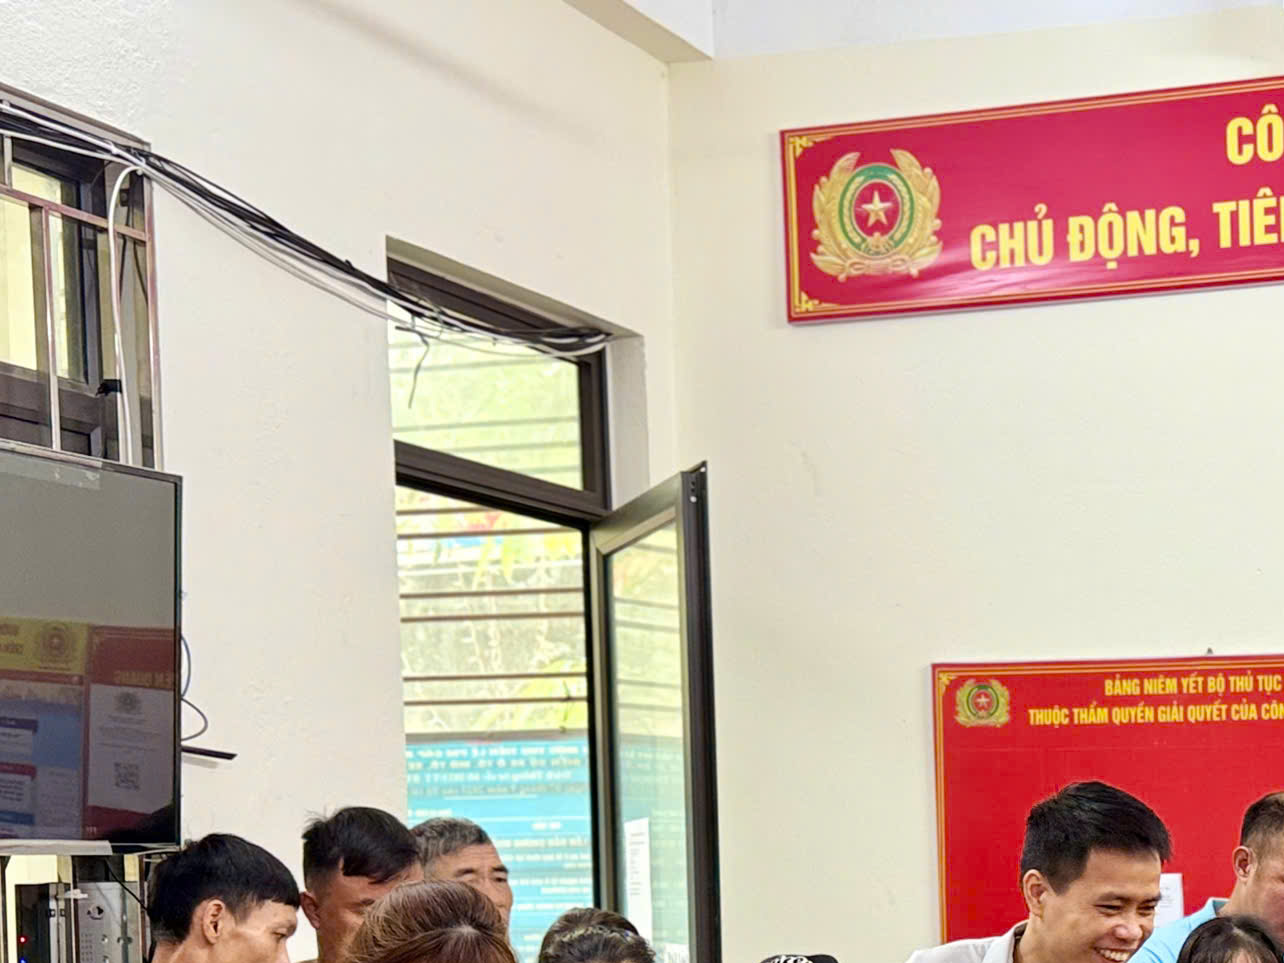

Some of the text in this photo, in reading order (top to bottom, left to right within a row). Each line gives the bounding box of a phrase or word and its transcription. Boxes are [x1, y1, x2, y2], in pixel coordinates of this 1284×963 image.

[969, 203, 1055, 271] CHỦ
[1067, 203, 1200, 272] ĐỘNG,
[1105, 675, 1140, 695] BẢNG
[1181, 674, 1204, 693] YẾT
[1208, 674, 1225, 693] BỘ
[1229, 672, 1253, 692] THỦ
[1257, 675, 1281, 694] TỤC
[1029, 706, 1069, 725] THUỘC
[1073, 705, 1108, 724] THẨM
[1112, 703, 1154, 724] QUYỀN
[1158, 701, 1184, 722] GIẢI
[1187, 701, 1227, 723] QUYẾT
[1231, 699, 1257, 720] CỦA
